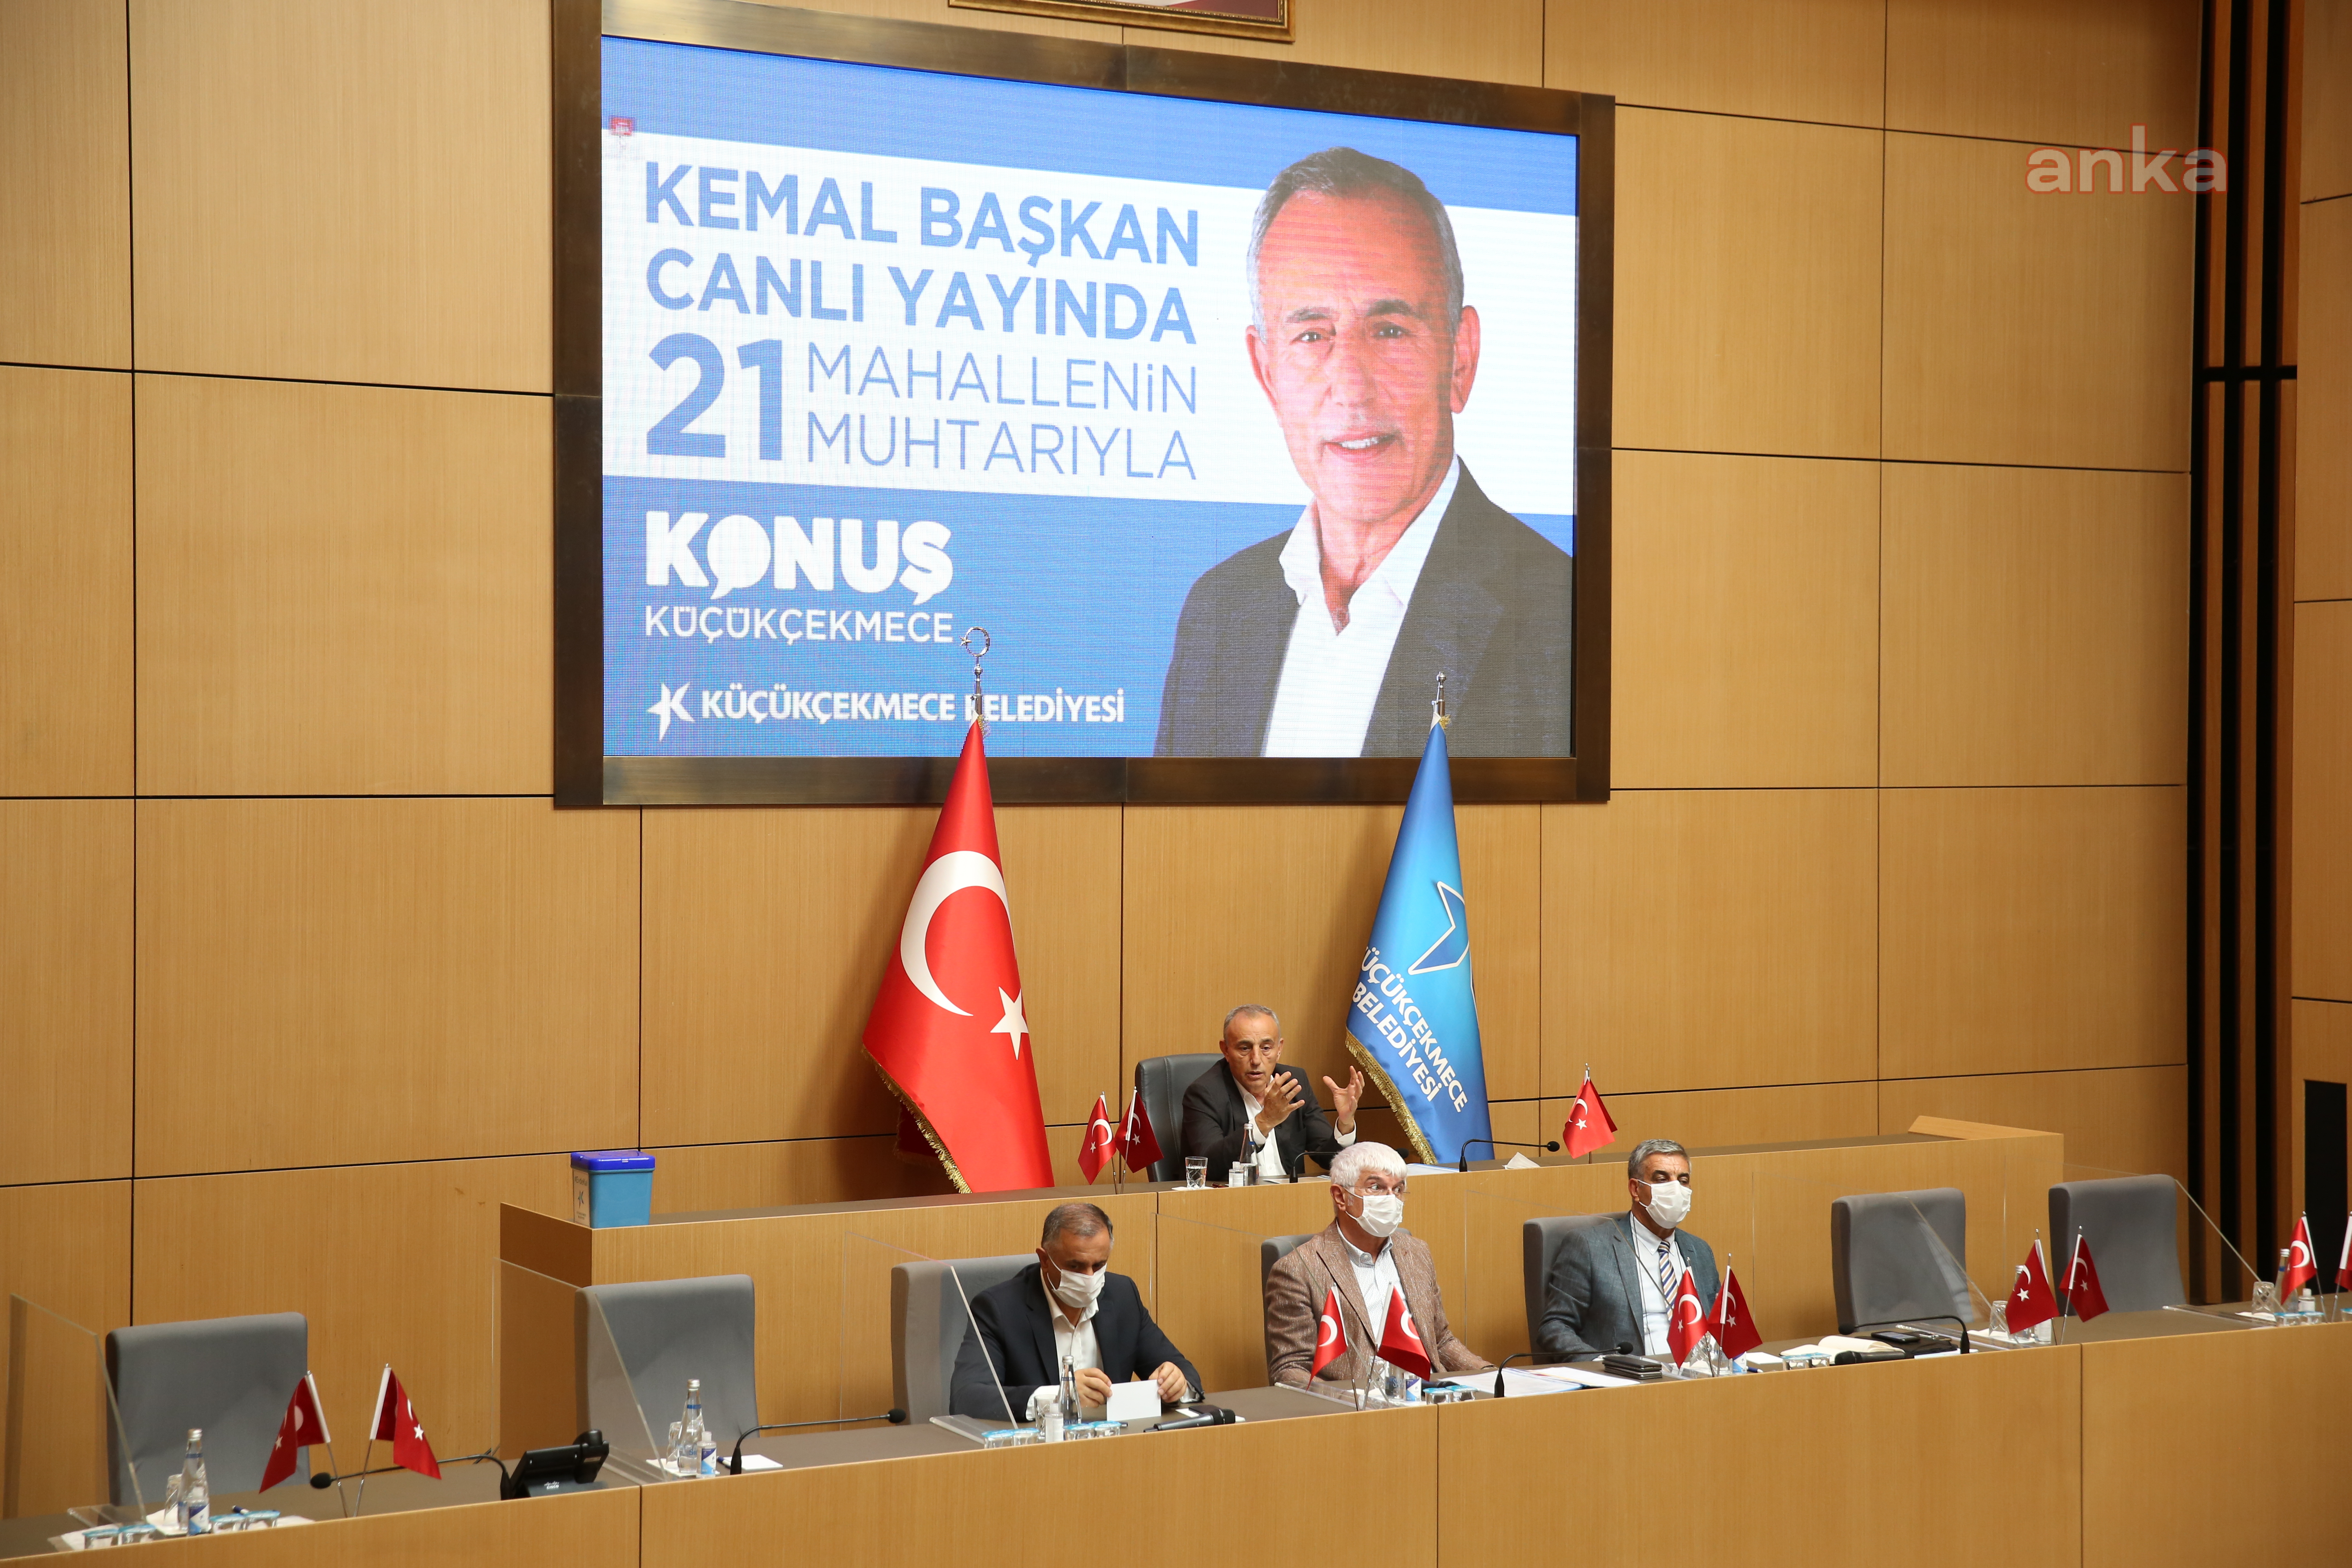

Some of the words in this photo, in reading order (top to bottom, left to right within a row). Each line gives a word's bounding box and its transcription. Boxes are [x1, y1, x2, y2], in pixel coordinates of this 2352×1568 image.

[646, 162, 898, 244] KEMAL
[920, 187, 1199, 267] BAŞKAN
[646, 248, 864, 322] CANLI
[888, 265, 1196, 344] YAYINDA
[647, 333, 782, 461] 21
[808, 412, 1196, 479] MUHTARIYLA
[645, 510, 954, 605] KONUŞ
[644, 604, 954, 645] KÜÇÜKÇEKMECE
[702, 682, 956, 725] KÜÇÜKÇEKMECE
[1352, 981, 1441, 1102] BELEDİYESİ
[1361, 946, 1468, 1113] ÜÇÜKÇEKMECE
